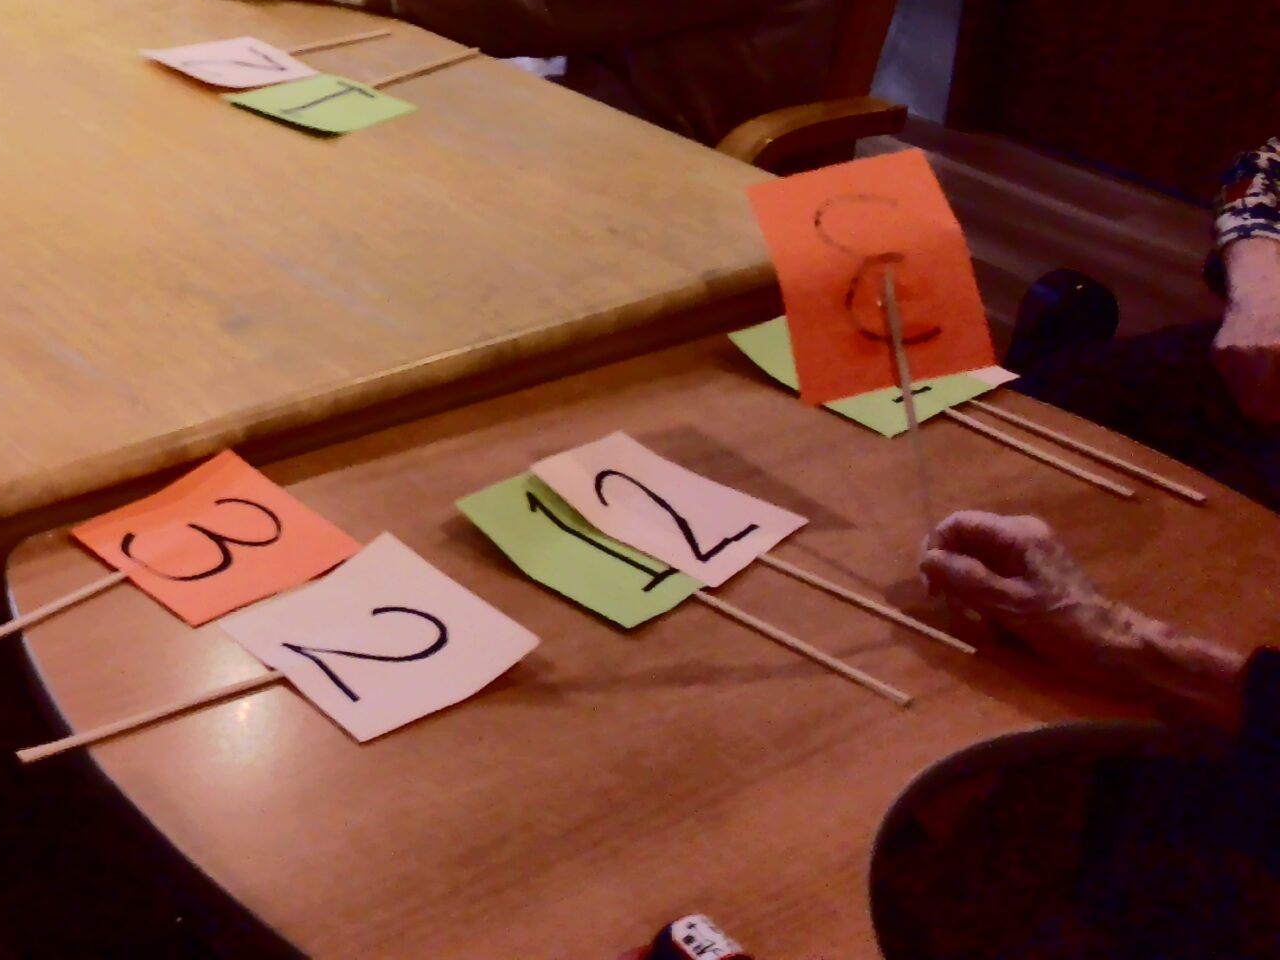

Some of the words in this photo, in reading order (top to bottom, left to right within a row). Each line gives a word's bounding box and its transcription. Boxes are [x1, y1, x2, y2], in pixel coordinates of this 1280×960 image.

[122, 497, 282, 582] 3
[525, 490, 681, 593] 1
[594, 468, 761, 563] 2
[282, 606, 449, 703] 2
